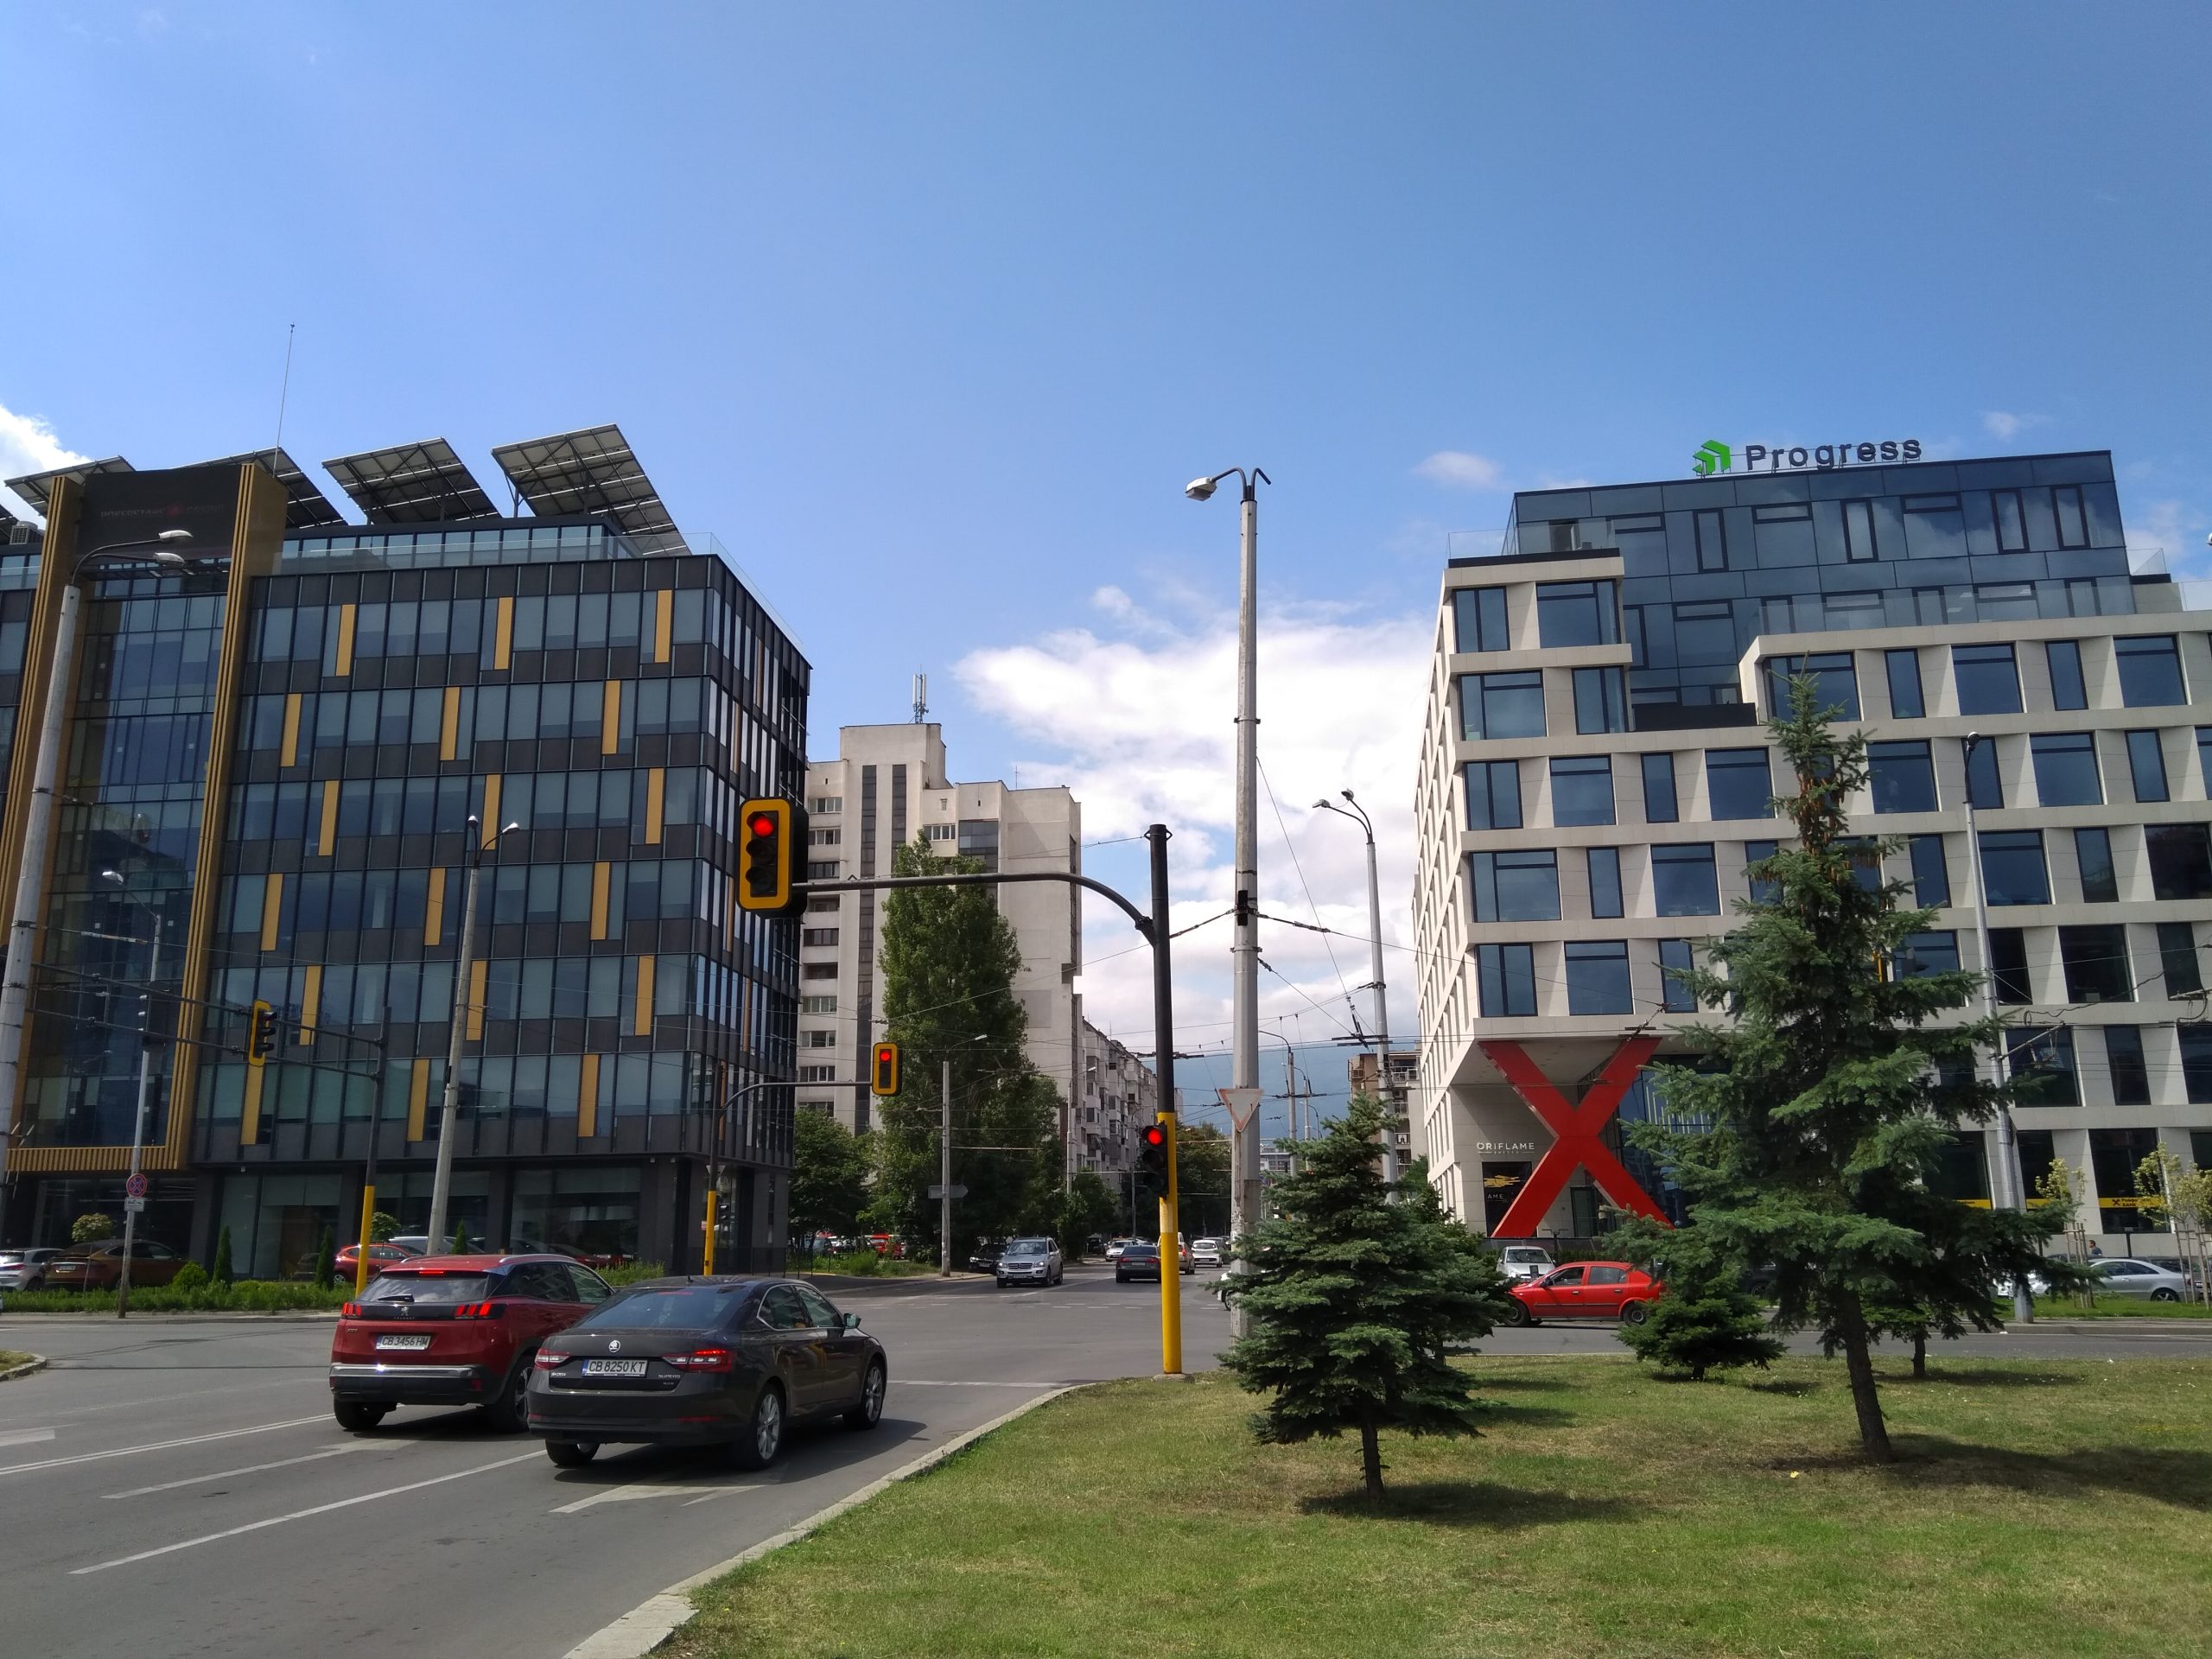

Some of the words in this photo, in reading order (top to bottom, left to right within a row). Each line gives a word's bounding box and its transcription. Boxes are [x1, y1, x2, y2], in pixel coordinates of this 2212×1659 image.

[1745, 439, 1923, 470] Progress
[382, 1337, 394, 1346] CB
[394, 1337, 415, 1346] 3456
[416, 1337, 429, 1346] HM
[588, 1361, 603, 1372] CB
[604, 1361, 629, 1372] 8250
[630, 1361, 645, 1374] KT
